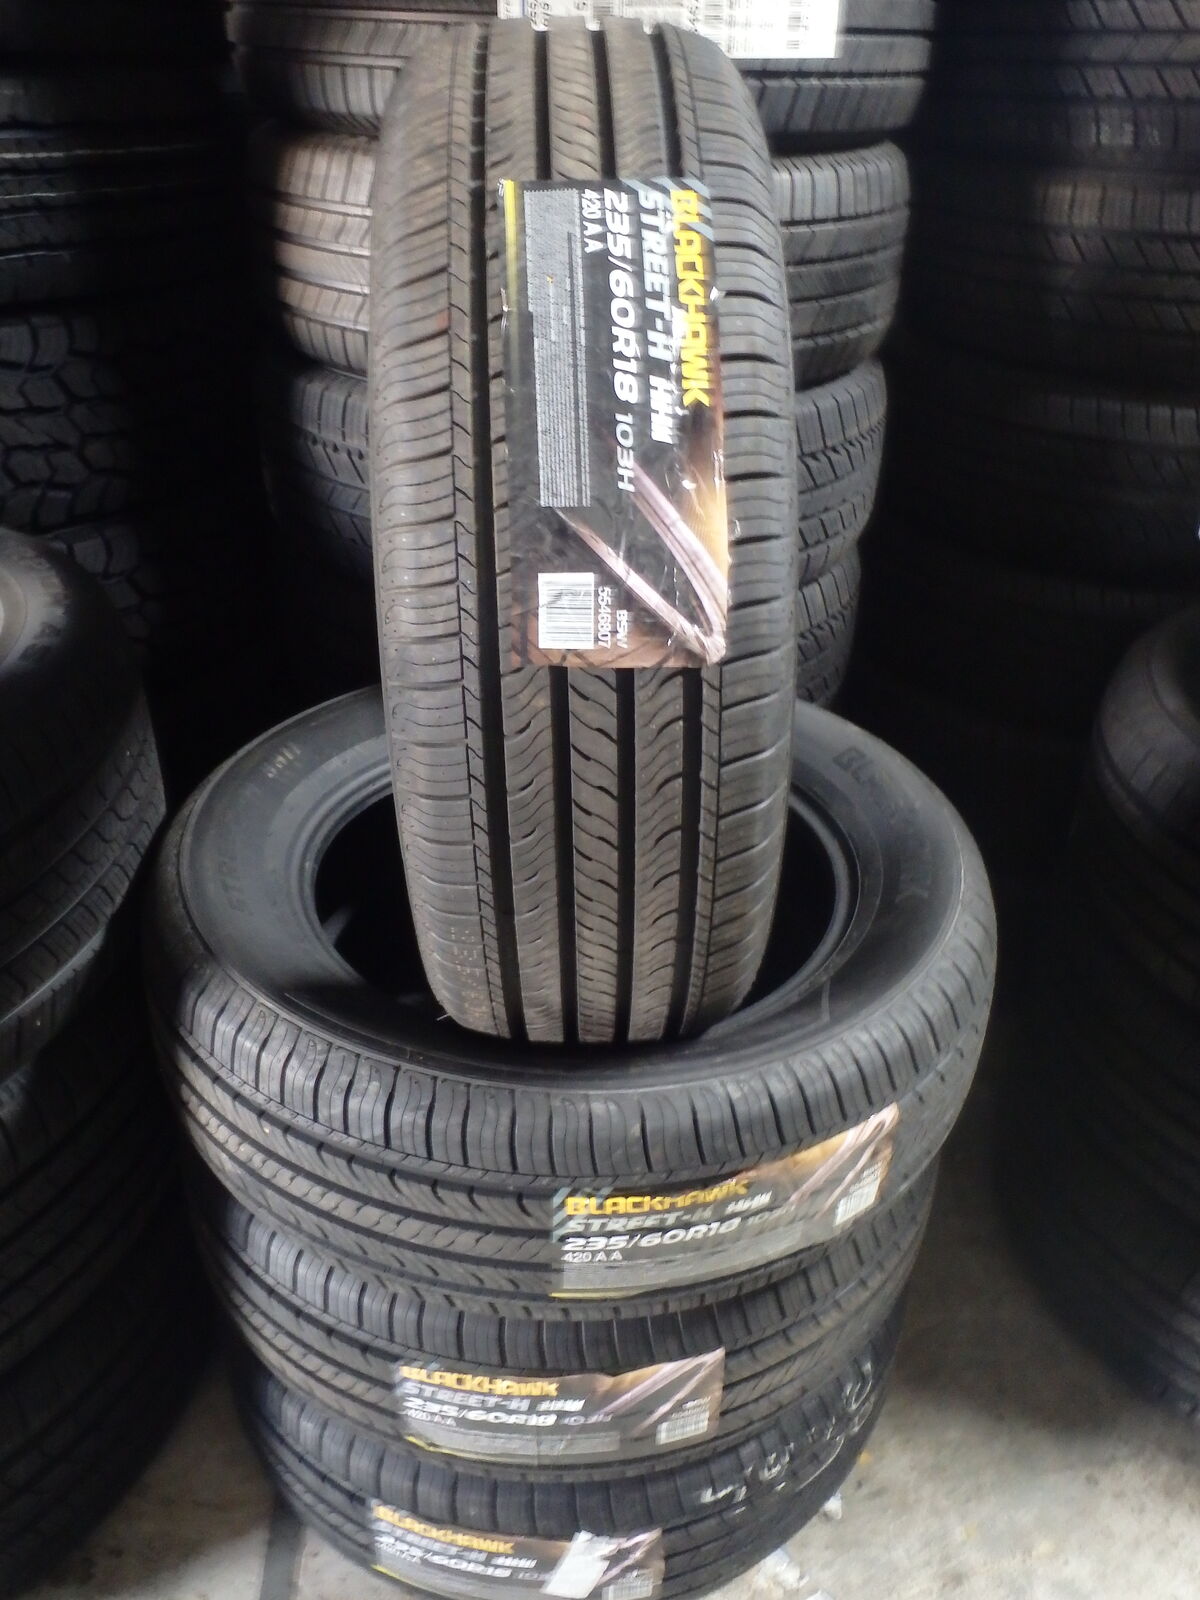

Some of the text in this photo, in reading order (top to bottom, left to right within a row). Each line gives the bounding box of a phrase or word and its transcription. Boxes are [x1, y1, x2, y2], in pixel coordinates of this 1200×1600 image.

[581, 189, 603, 253] 420 A A
[639, 188, 673, 362] STREET-H
[671, 189, 711, 407] BLACKHAWK
[604, 188, 640, 492] 235/60R18 103H
[598, 586, 611, 649] 5546807
[616, 609, 628, 648] BSW
[565, 1178, 749, 1215] BLACKHAWK
[401, 1365, 560, 1397] BLACKHAWK
[402, 1382, 531, 1411] STREET-H
[402, 1397, 558, 1427] 235/60R18
[373, 1505, 514, 1555] BLACKHAWK
